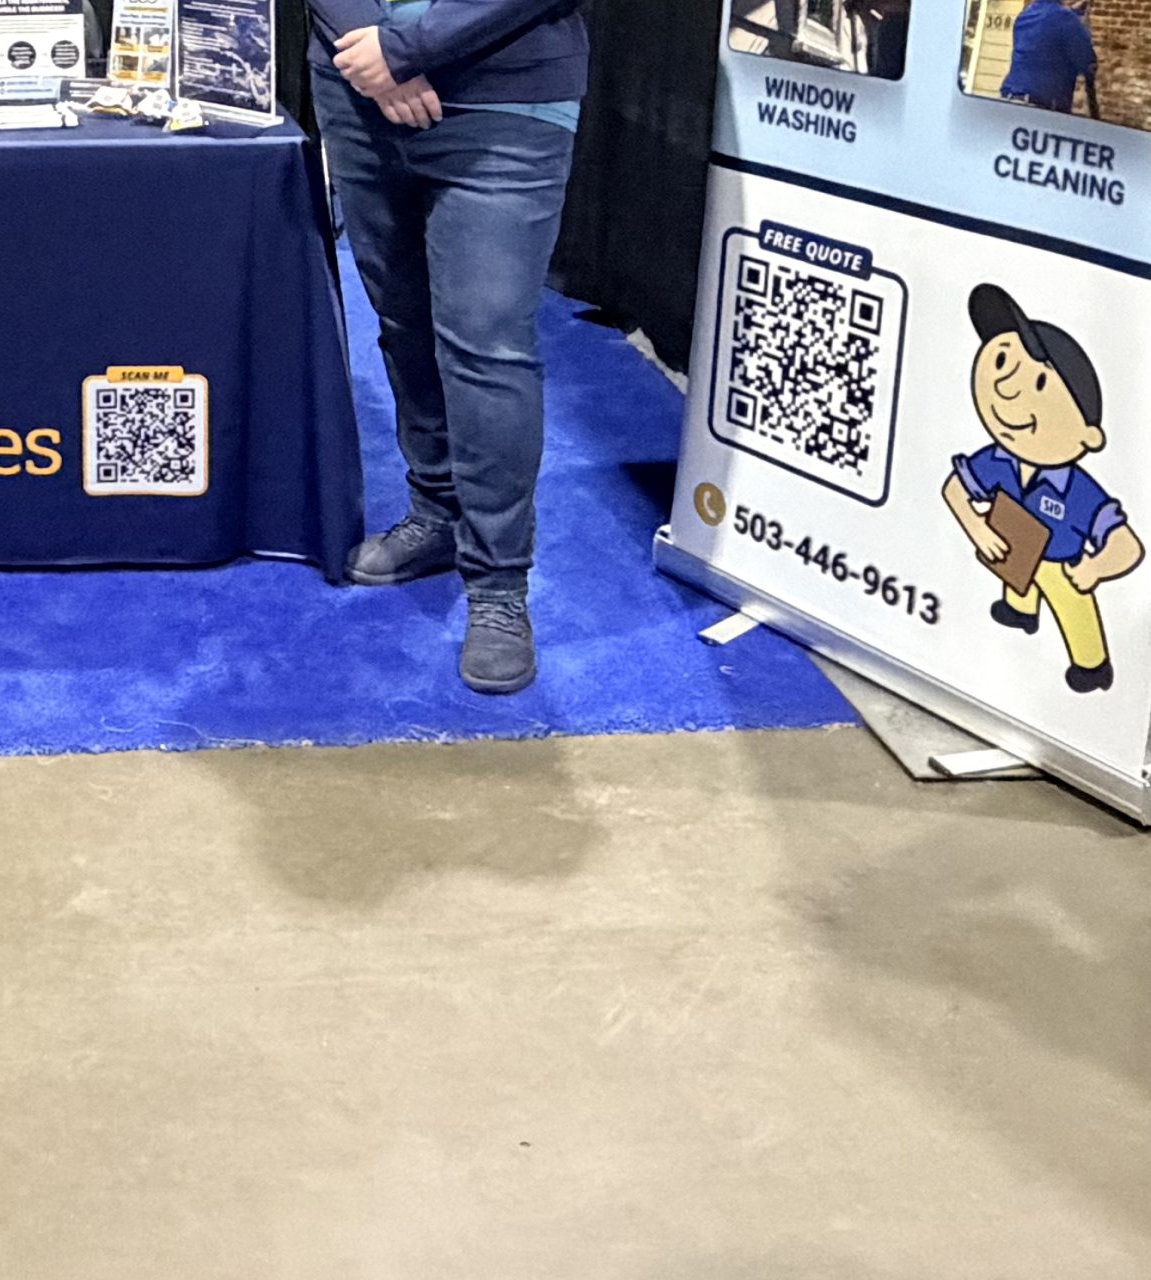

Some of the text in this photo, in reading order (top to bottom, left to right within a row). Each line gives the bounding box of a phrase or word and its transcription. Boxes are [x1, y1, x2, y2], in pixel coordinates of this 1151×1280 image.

[765, 76, 856, 115] WINDOW
[757, 102, 857, 144] WASHING
[1011, 127, 1116, 171] GUTTER
[993, 154, 1126, 205] CLEANING
[763, 229, 864, 272] FREE QUOTE
[121, 371, 170, 381] SCAN ME
[734, 504, 941, 626] 503-446-9613
